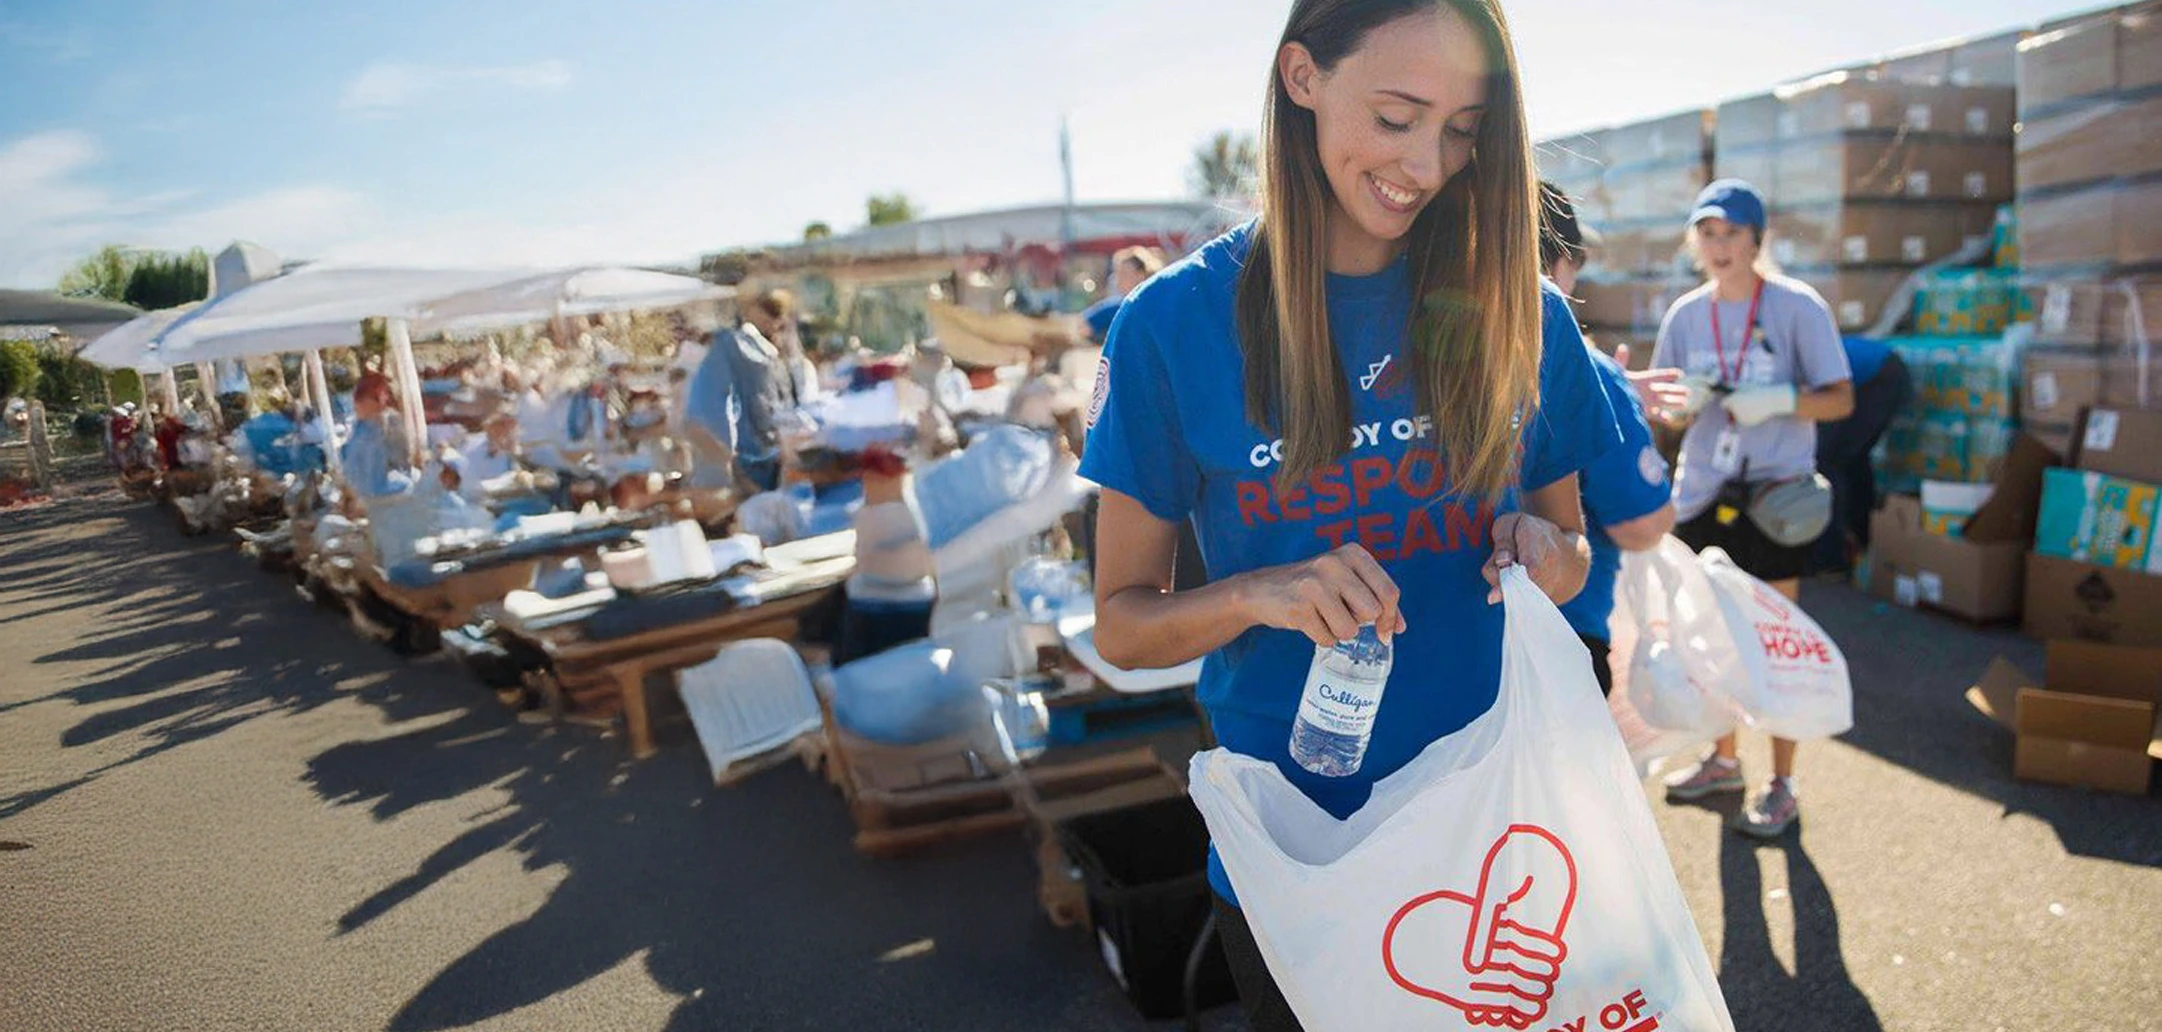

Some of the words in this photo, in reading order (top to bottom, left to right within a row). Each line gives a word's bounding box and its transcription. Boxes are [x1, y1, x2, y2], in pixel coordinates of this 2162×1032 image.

[1390, 414, 1434, 441] OF
[1314, 500, 1494, 561] TEAM
[1599, 988, 1648, 1031] OF
